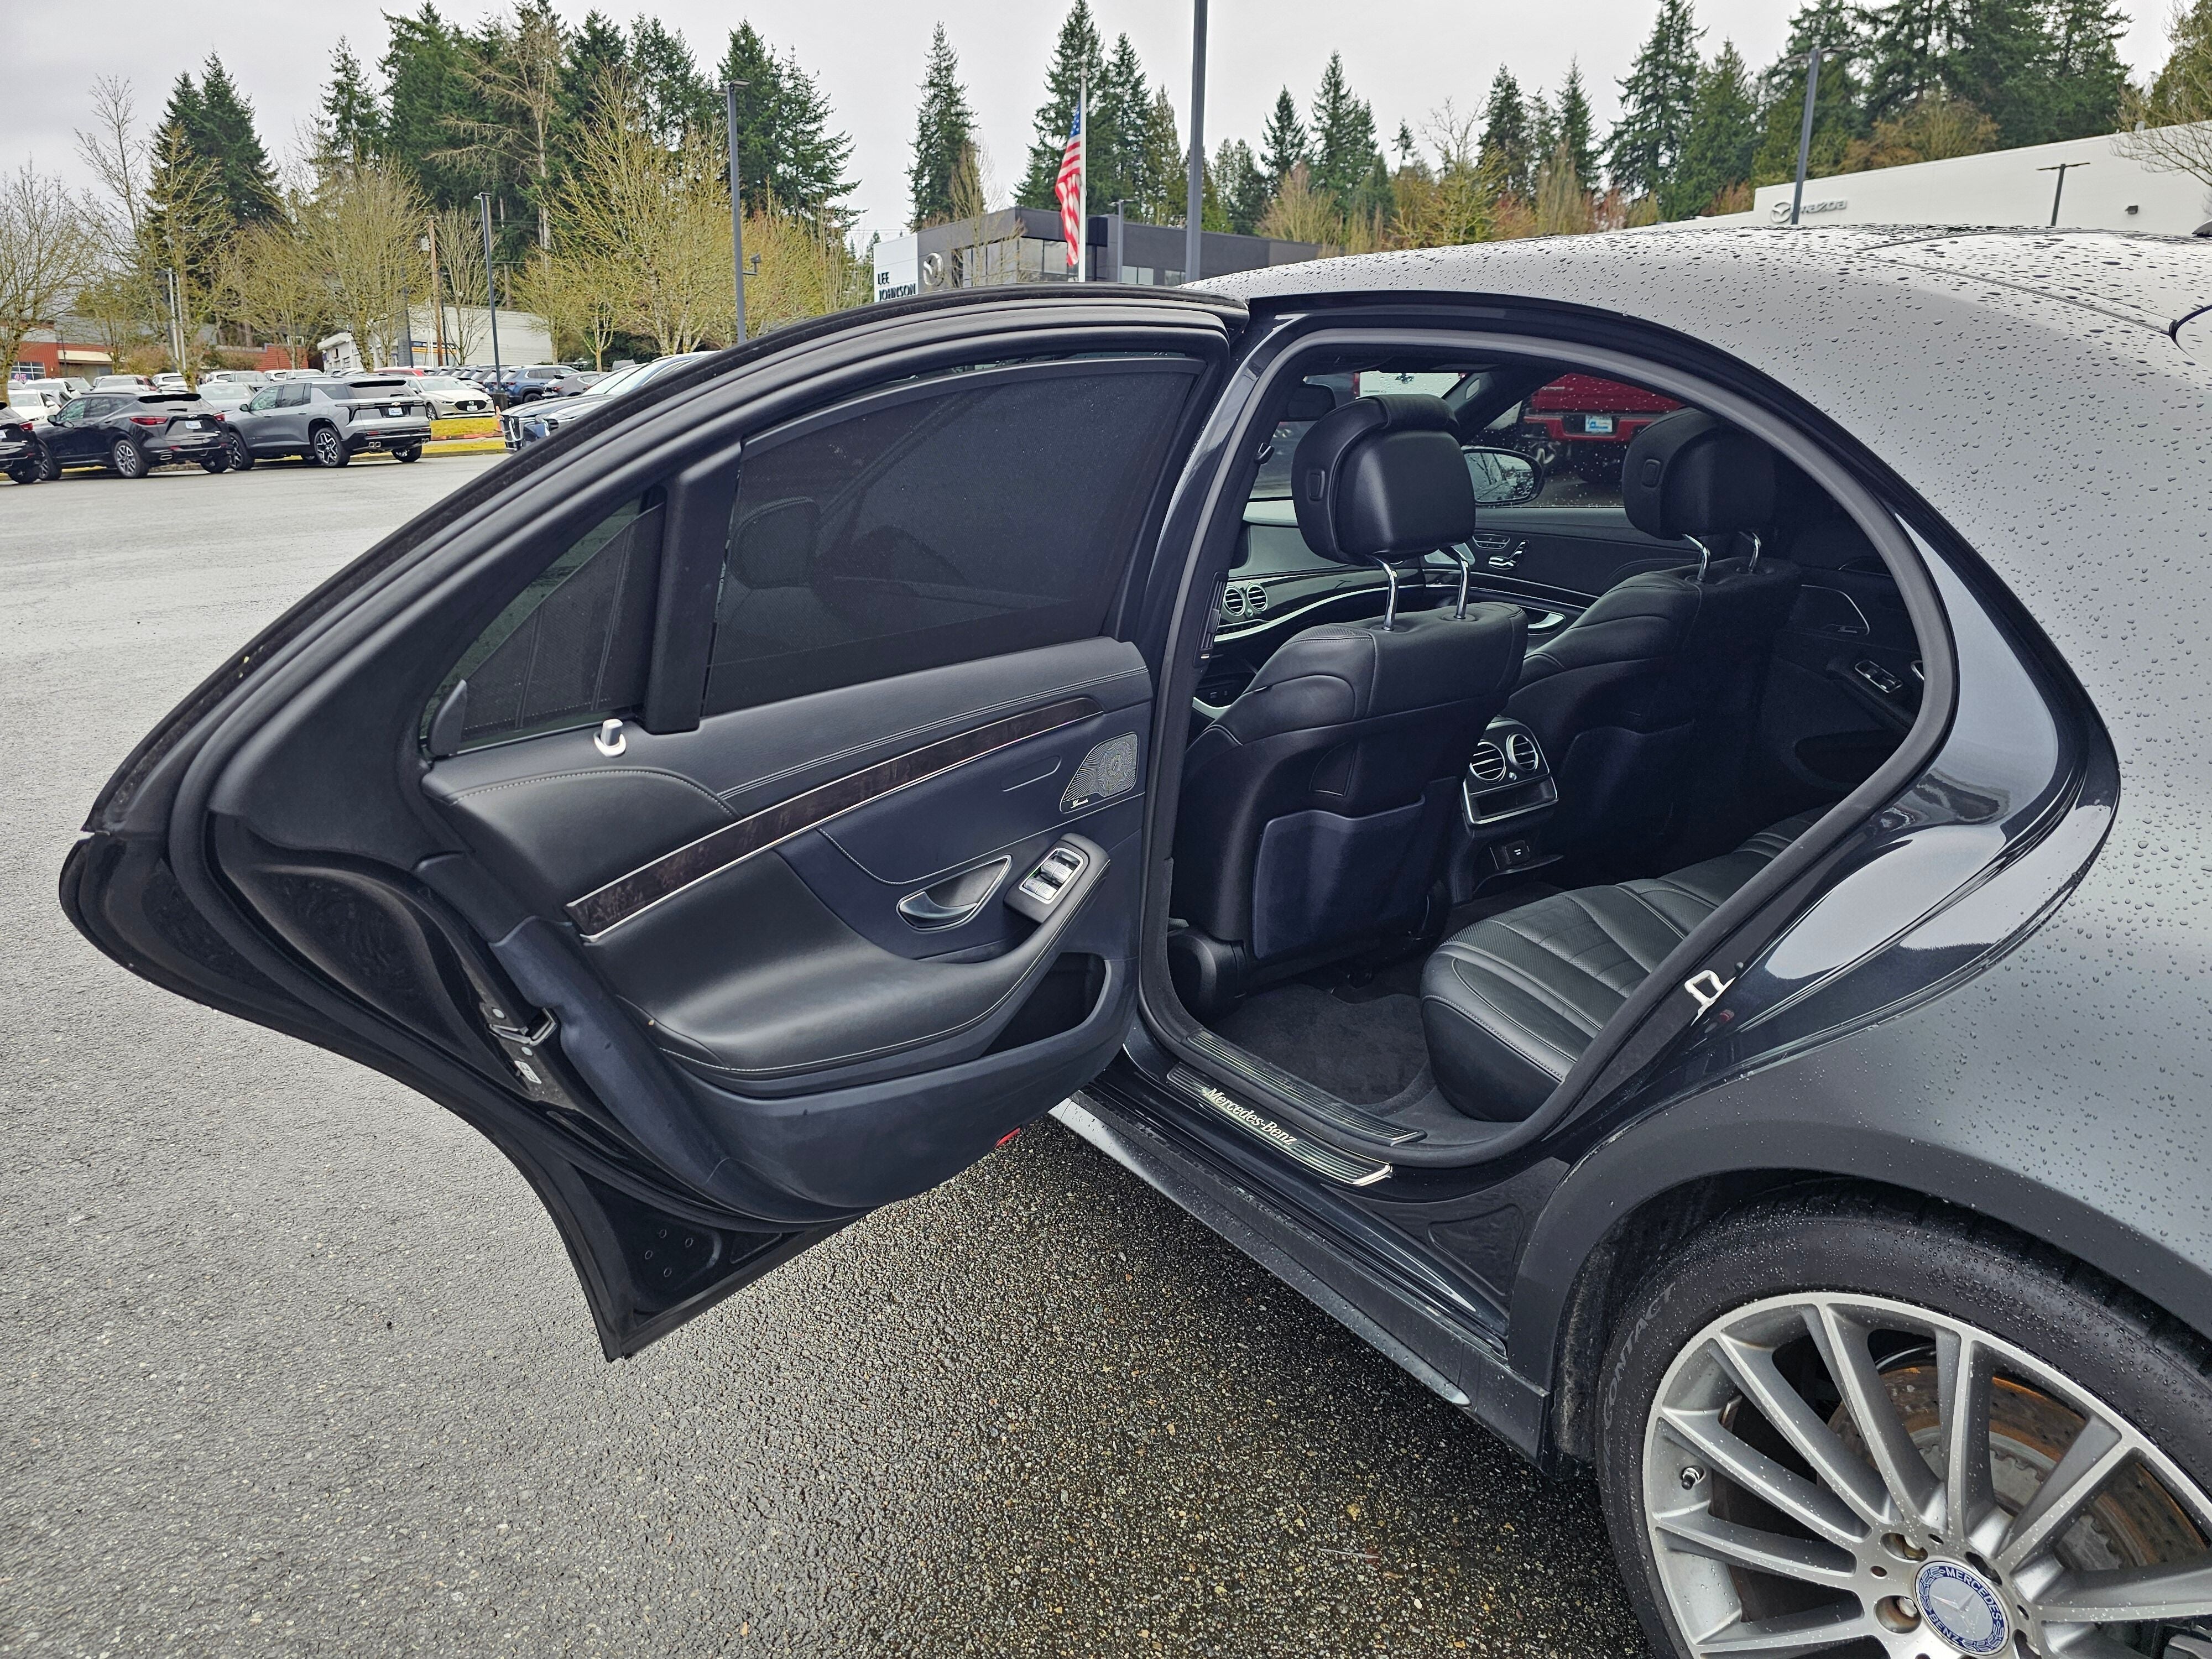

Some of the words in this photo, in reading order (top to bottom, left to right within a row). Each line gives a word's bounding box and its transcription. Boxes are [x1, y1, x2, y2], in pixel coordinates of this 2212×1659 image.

[878, 272, 890, 285] LEE
[879, 283, 916, 301] JOHNSON
[1207, 1088, 1297, 1145] Mercedes-Benz
[1945, 1566, 2002, 1621] MERCEDES
[1928, 1613, 1961, 1645] BENZ
